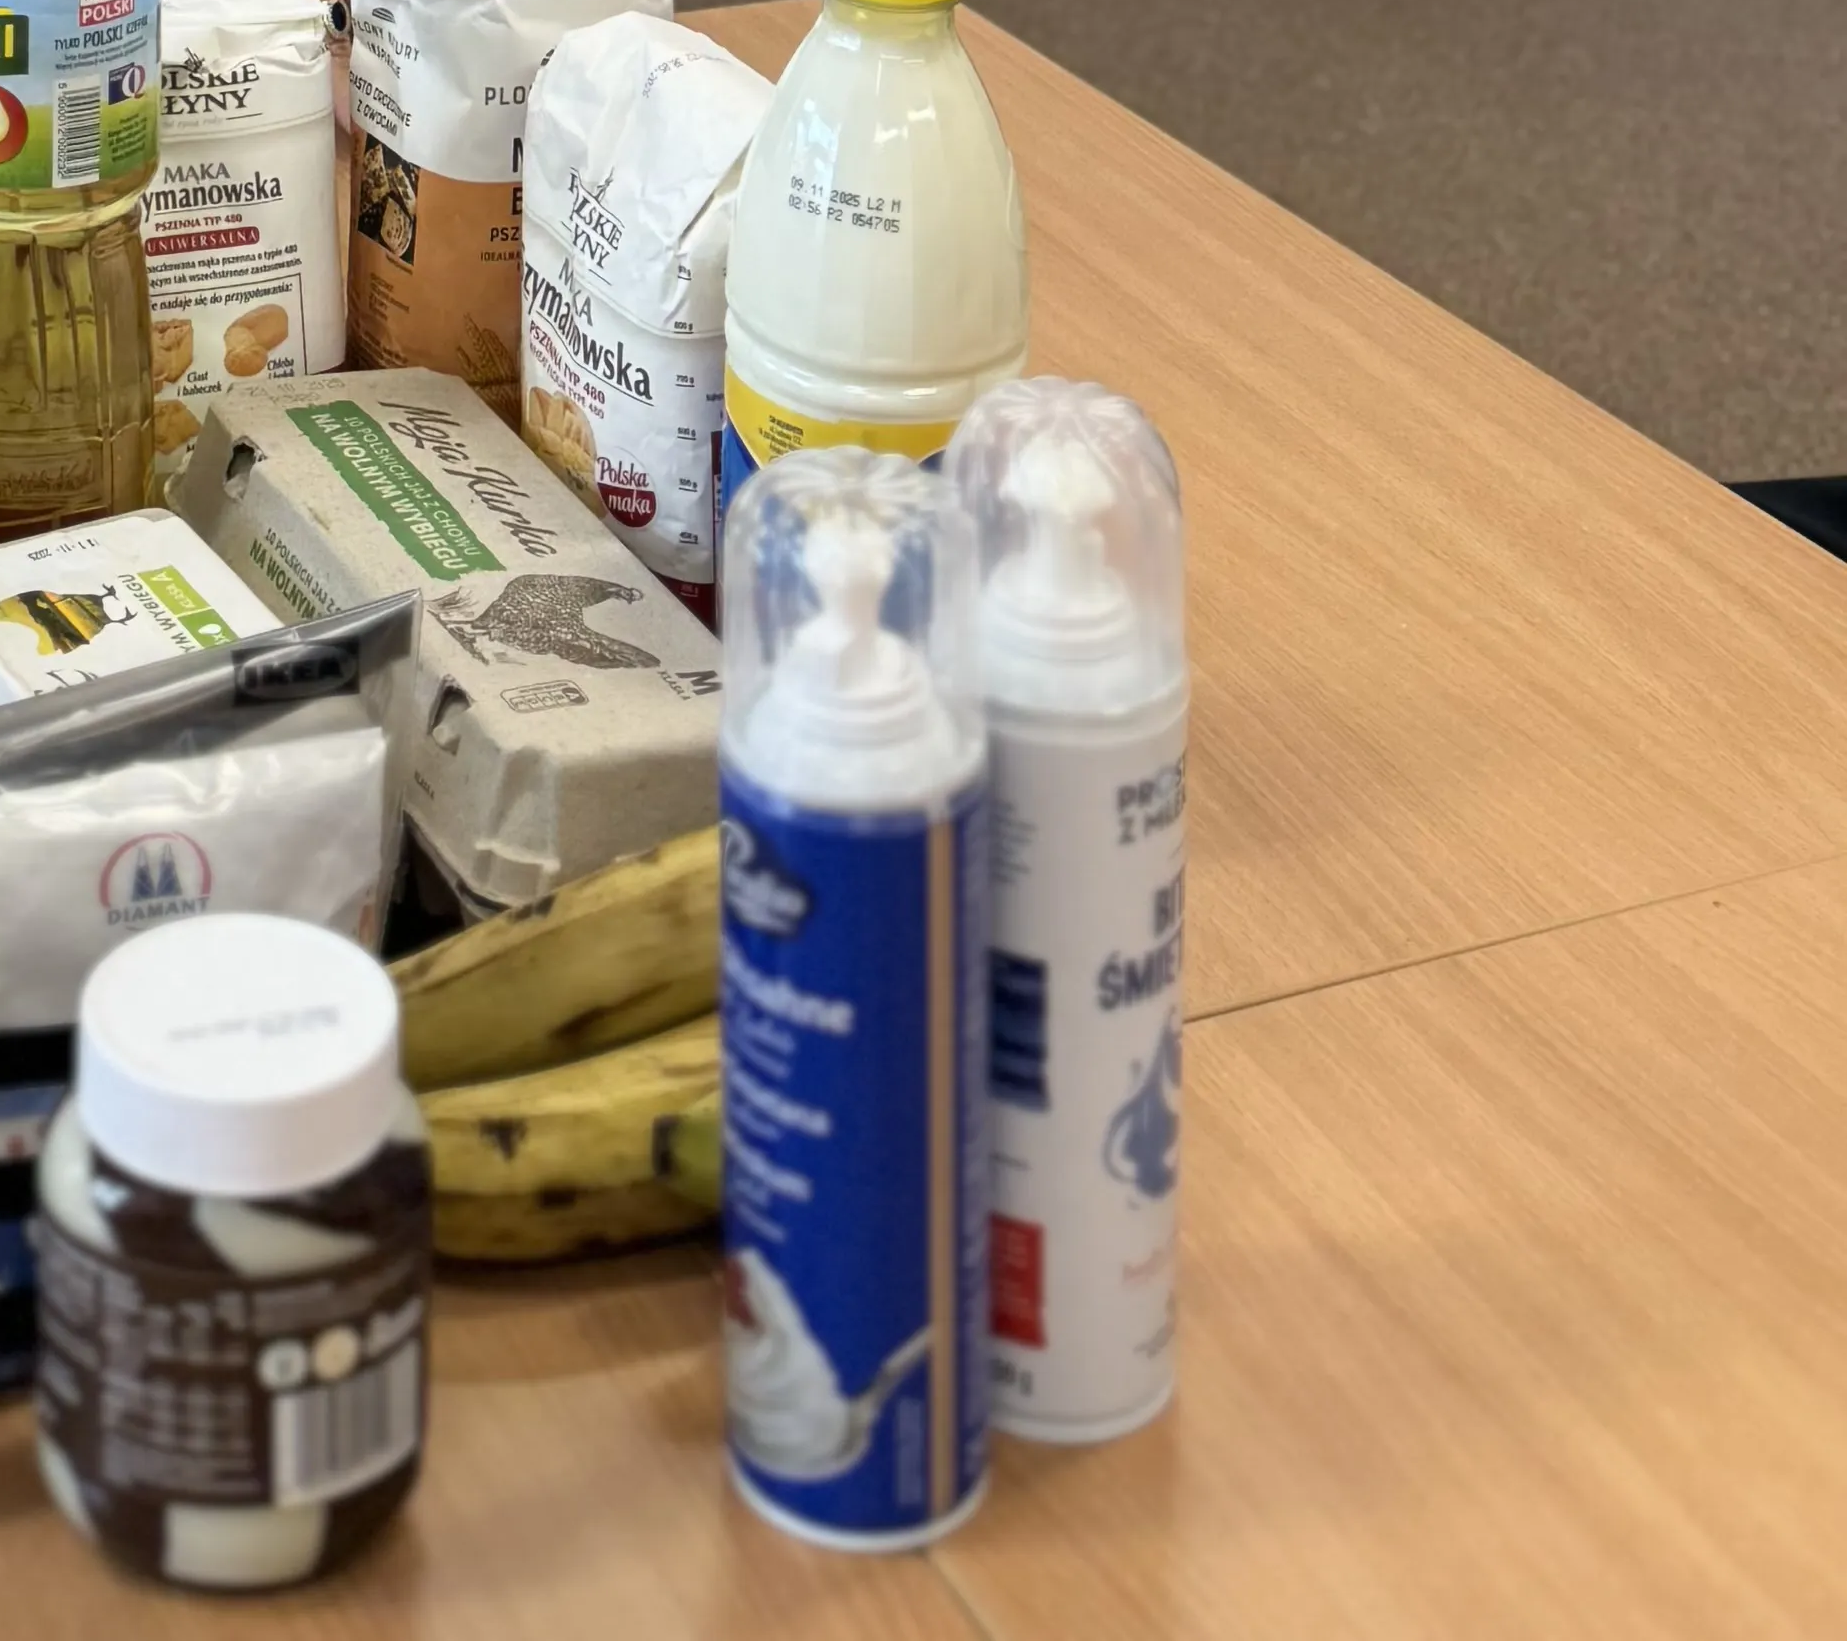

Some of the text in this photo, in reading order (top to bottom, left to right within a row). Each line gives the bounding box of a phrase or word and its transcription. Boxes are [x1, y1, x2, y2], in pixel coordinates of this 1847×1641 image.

[83, 24, 123, 49] POLSKI
[164, 163, 231, 185] MĄKA
[827, 207, 844, 222] P2
[852, 213, 900, 234] 054705
[867, 197, 885, 212] L2
[891, 199, 901, 214] M
[155, 216, 201, 232] PSZENNA
[203, 214, 221, 226] TYP
[147, 228, 259, 253] UNIWERSALNA
[583, 381, 605, 406] 480
[377, 401, 471, 465] Moja
[442, 465, 558, 558] Kurka
[597, 456, 650, 489] Polska
[310, 412, 469, 570] NA WOLNYM WYBIEGU
[362, 428, 406, 483] POLSKICH
[404, 479, 430, 504] JAJ
[433, 507, 481, 557] CHOWU
[608, 488, 651, 520] mąka
[276, 539, 313, 587] POLSKICH
[250, 540, 316, 620] NA WOLNYM
[119, 574, 181, 633] WYBIEGU
[244, 655, 345, 690] IKEA
[105, 896, 212, 927] DIAMANT
